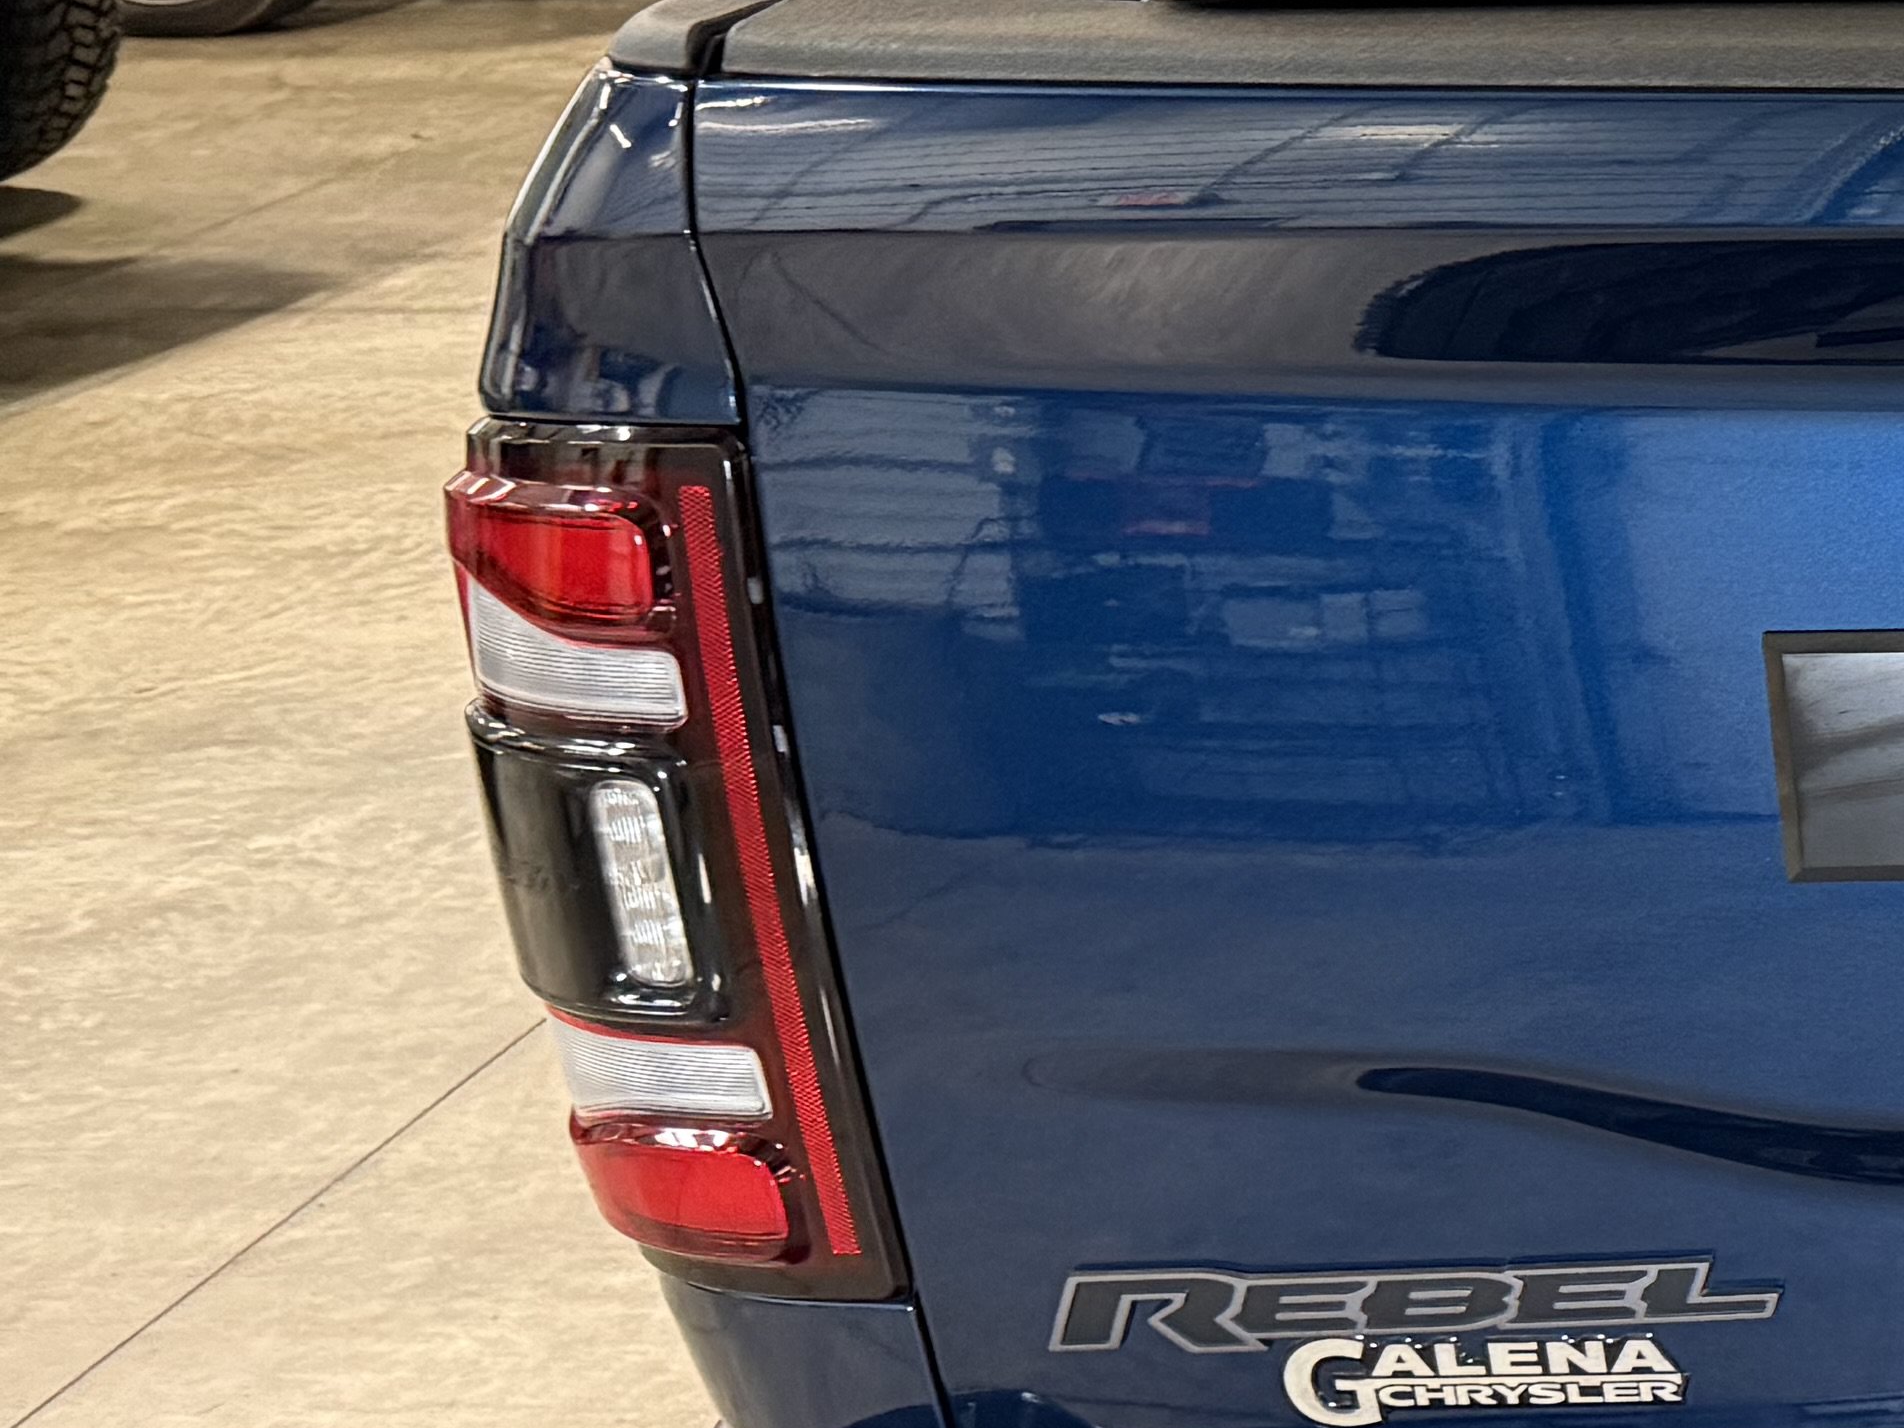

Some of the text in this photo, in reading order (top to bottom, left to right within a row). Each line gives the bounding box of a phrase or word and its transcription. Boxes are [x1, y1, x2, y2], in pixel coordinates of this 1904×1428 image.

[1048, 1256, 1784, 1352] REBEL
[1283, 1336, 1683, 1428] GALENA
[1377, 1380, 1683, 1407] CHRYSLER
